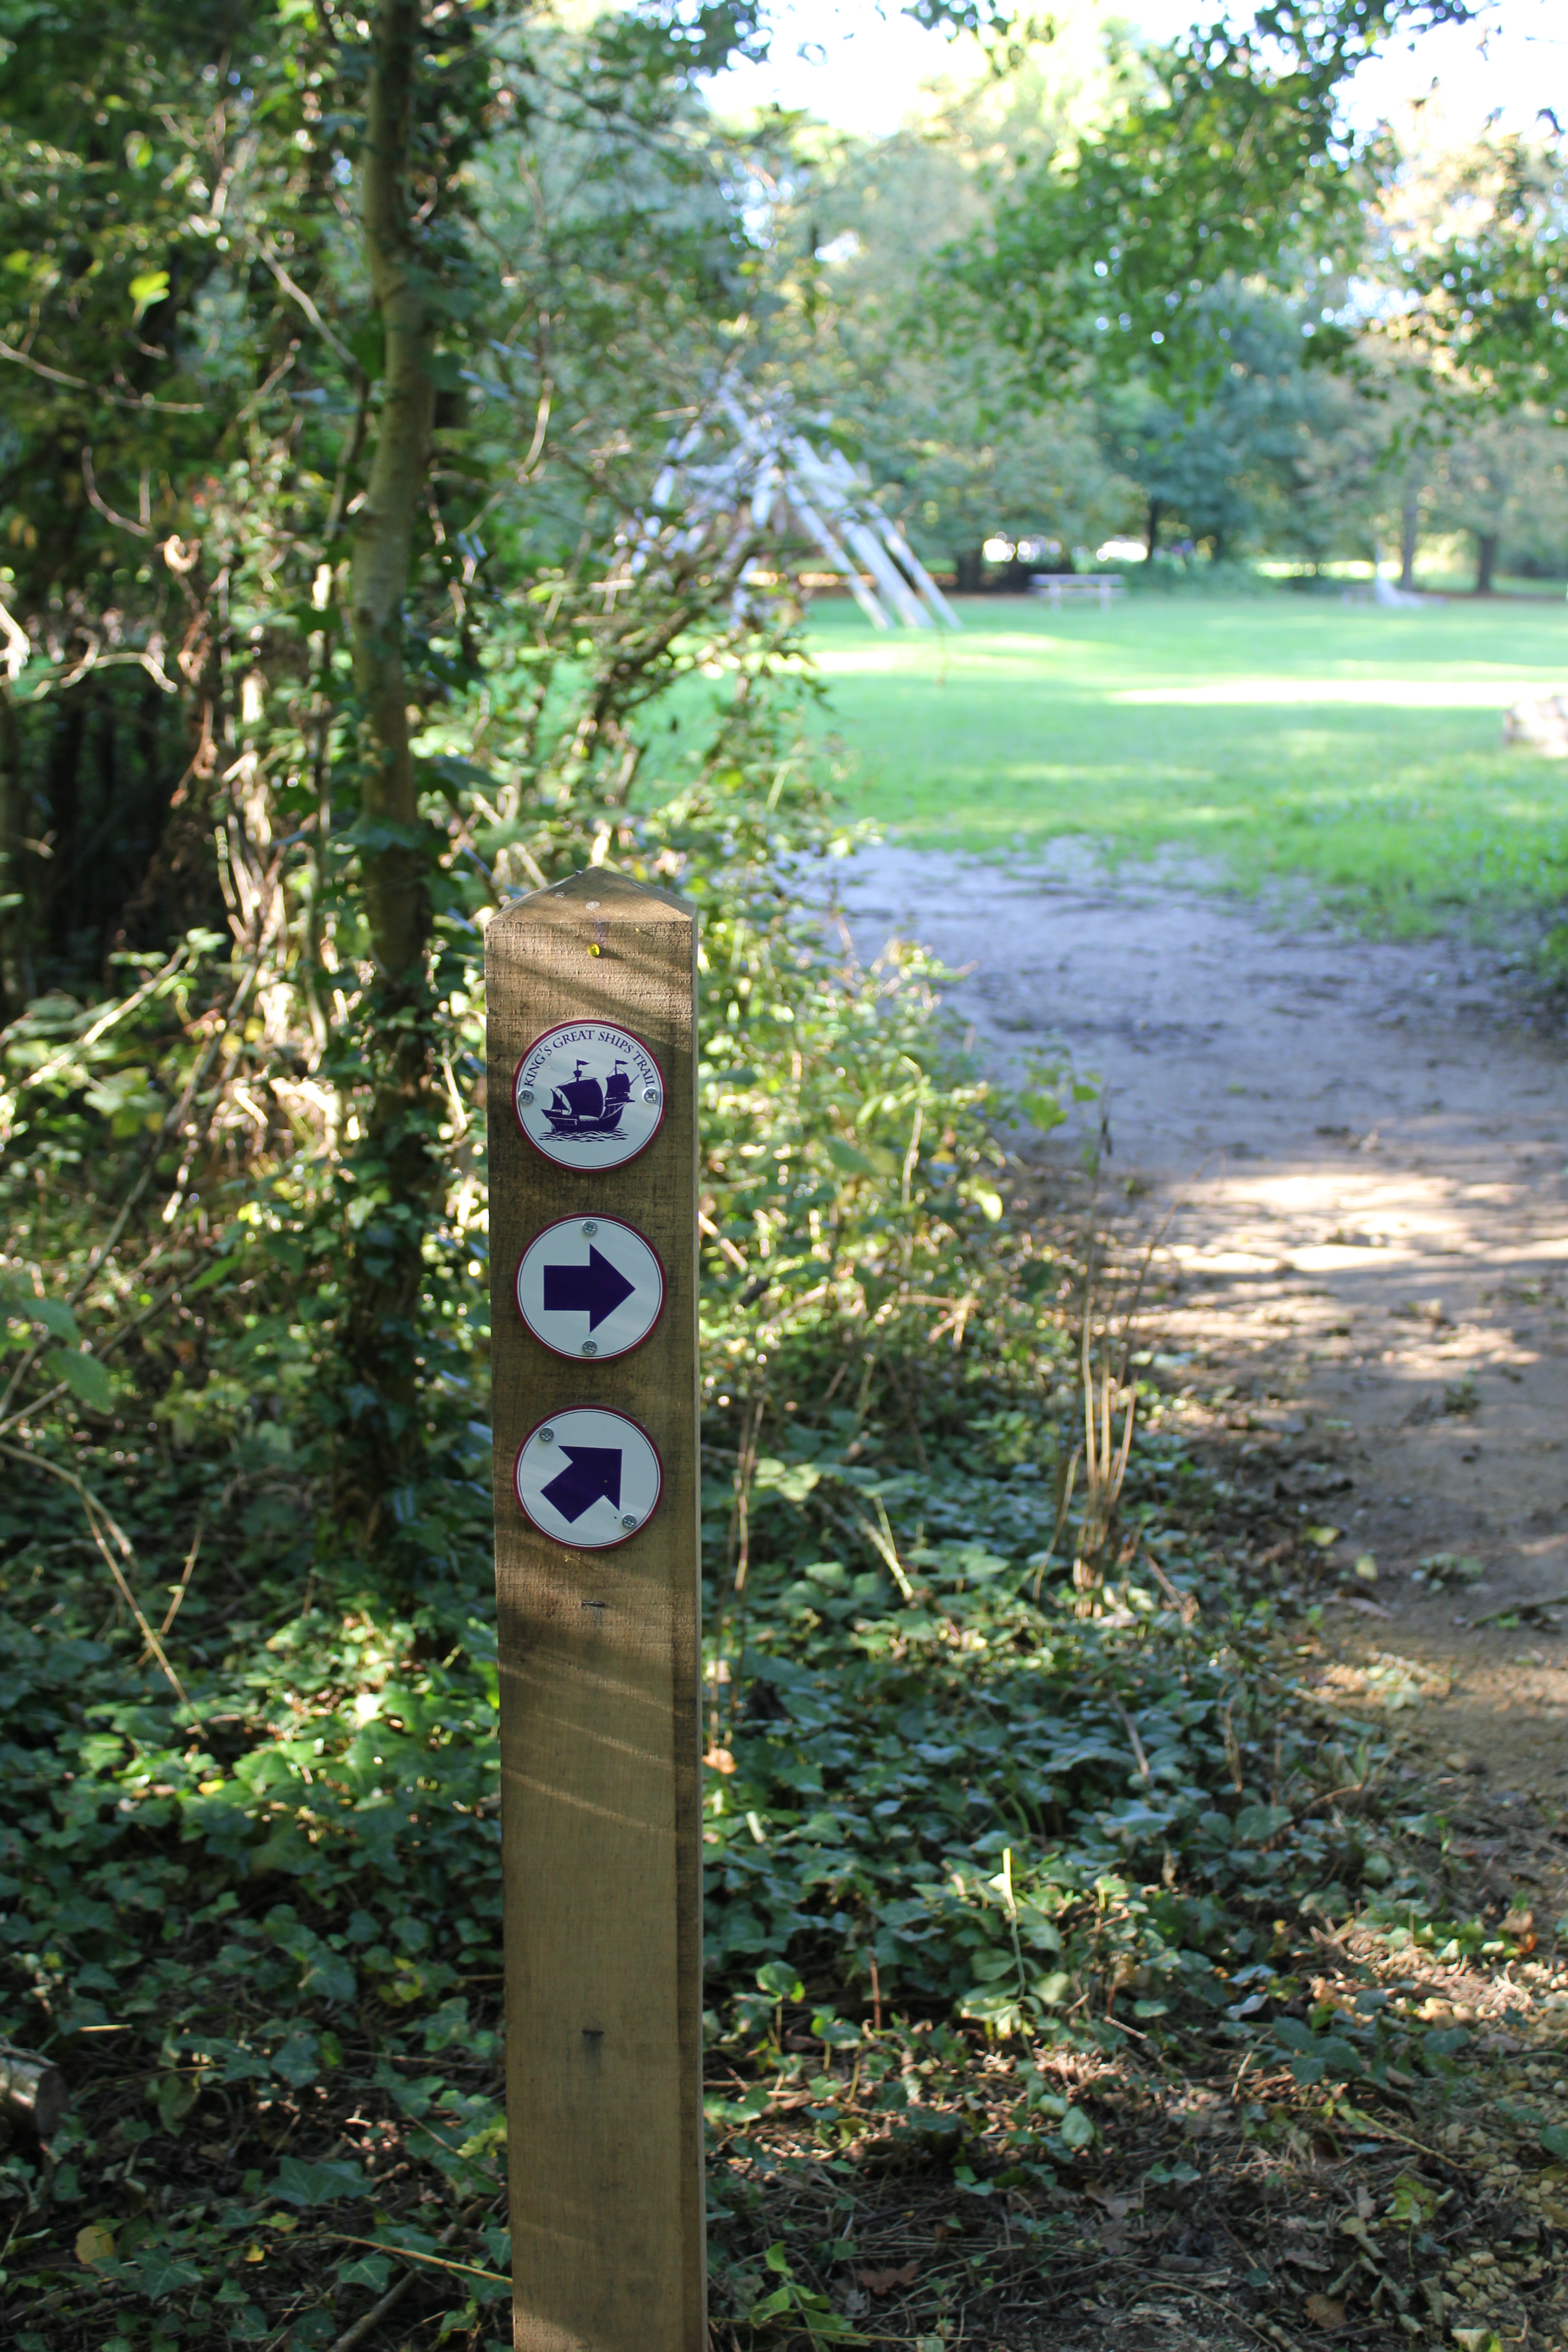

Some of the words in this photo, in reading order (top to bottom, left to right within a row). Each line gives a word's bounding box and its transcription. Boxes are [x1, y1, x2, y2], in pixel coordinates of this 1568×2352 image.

[524, 1045, 552, 1087] KING'S
[553, 1030, 595, 1048] GREAT
[598, 1031, 634, 1053] SHIPS
[632, 1051, 655, 1087] TRAIL
